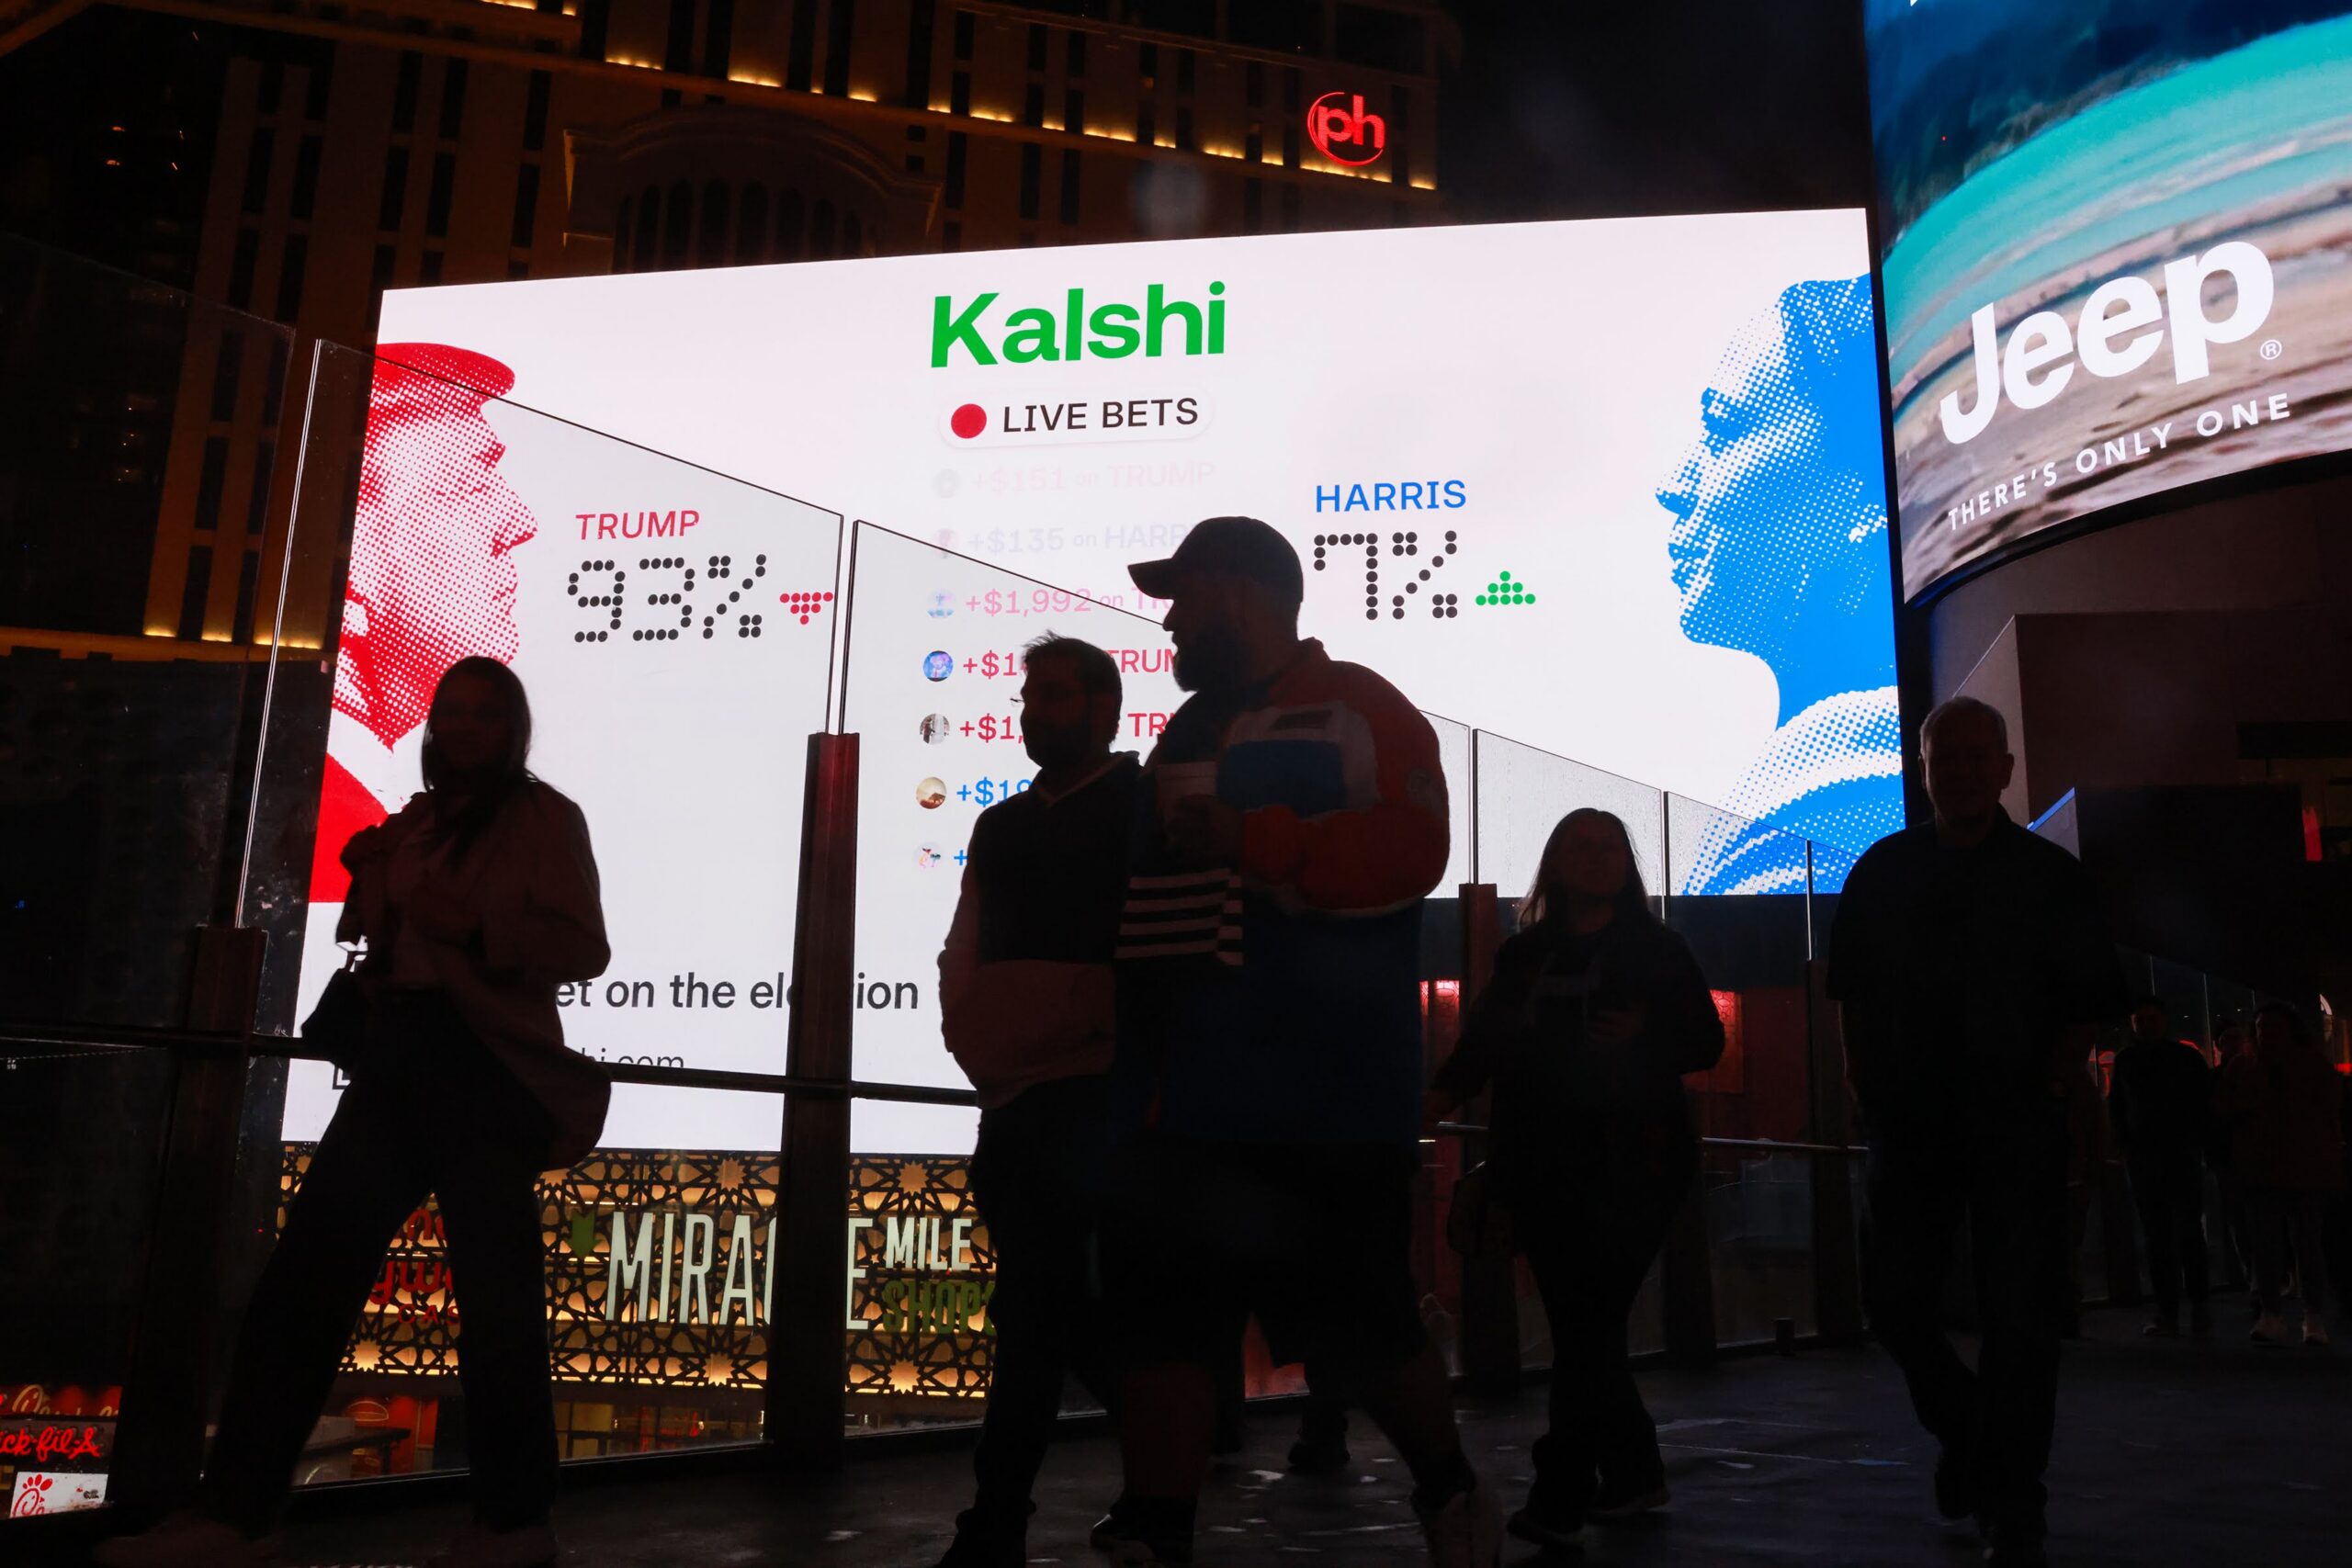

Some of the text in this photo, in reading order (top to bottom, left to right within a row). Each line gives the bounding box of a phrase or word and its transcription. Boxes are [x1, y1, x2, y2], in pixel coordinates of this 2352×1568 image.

[1317, 94, 1385, 150] ph
[931, 280, 1226, 367] Kalshi
[1939, 241, 2275, 445] Jeep
[1002, 397, 1199, 433] LIVE BETS
[1074, 471, 1100, 488] on
[1107, 460, 1216, 488] TRUMP
[1947, 392, 2291, 531] THERE'S ONLY ONE
[1316, 479, 1467, 513] HARRIS
[575, 509, 700, 540] TRUMP
[967, 524, 1196, 556] +$135 on HARR
[566, 553, 767, 643] 93%
[965, 587, 1093, 618] +$1,992
[1099, 593, 1124, 609] on
[1314, 530, 1458, 621] 7%
[555, 972, 919, 1010] et on the elion
[605, 1211, 874, 1330] MIRAE
[885, 1216, 972, 1271] MILE
